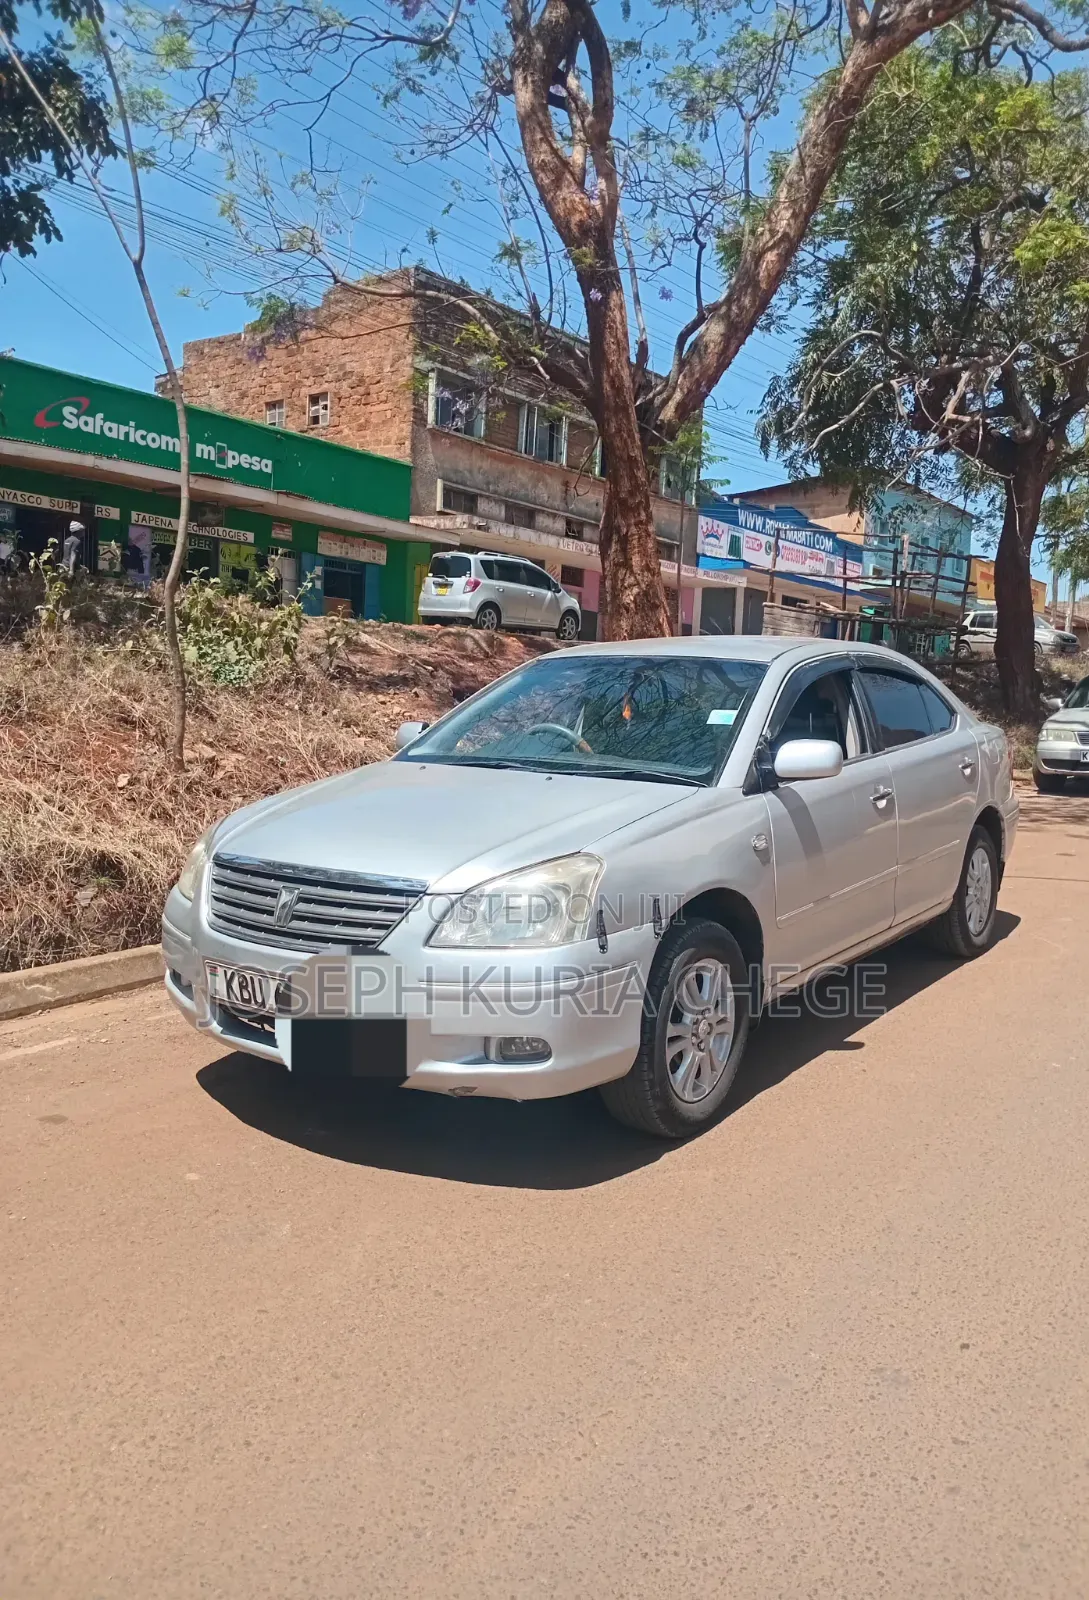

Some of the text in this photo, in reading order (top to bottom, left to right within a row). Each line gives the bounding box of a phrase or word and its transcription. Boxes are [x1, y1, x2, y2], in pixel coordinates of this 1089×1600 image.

[62, 405, 190, 453] Safaricom
[134, 512, 174, 529] JAPENA
[186, 522, 249, 542] ECHNOLOGIES
